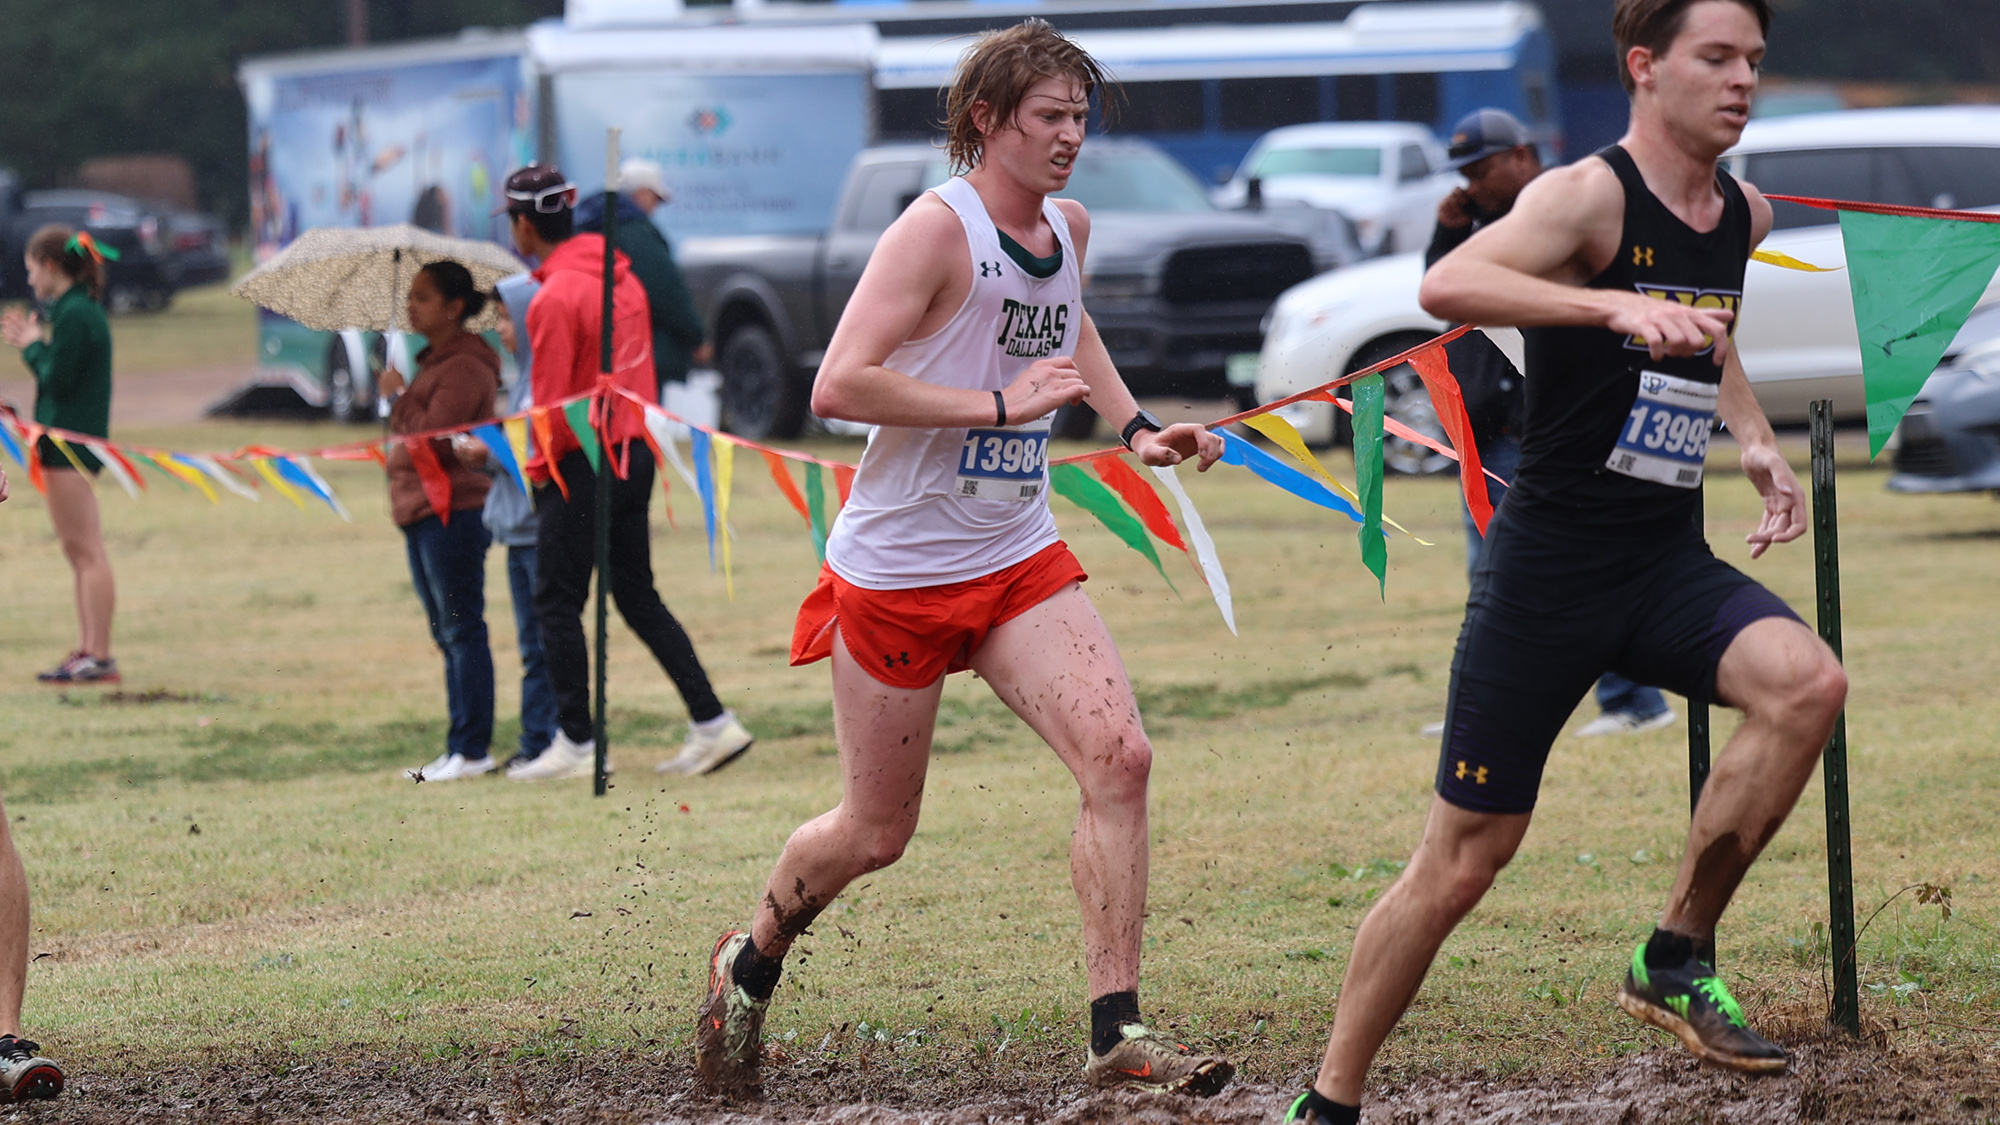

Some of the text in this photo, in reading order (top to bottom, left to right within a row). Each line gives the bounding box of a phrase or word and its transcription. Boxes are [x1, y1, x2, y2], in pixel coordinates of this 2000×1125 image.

[998, 298, 1068, 350] TEXAS
[1006, 338, 1052, 358] DALLAS
[1626, 405, 1713, 458] 13995
[964, 435, 1048, 474] 13984
